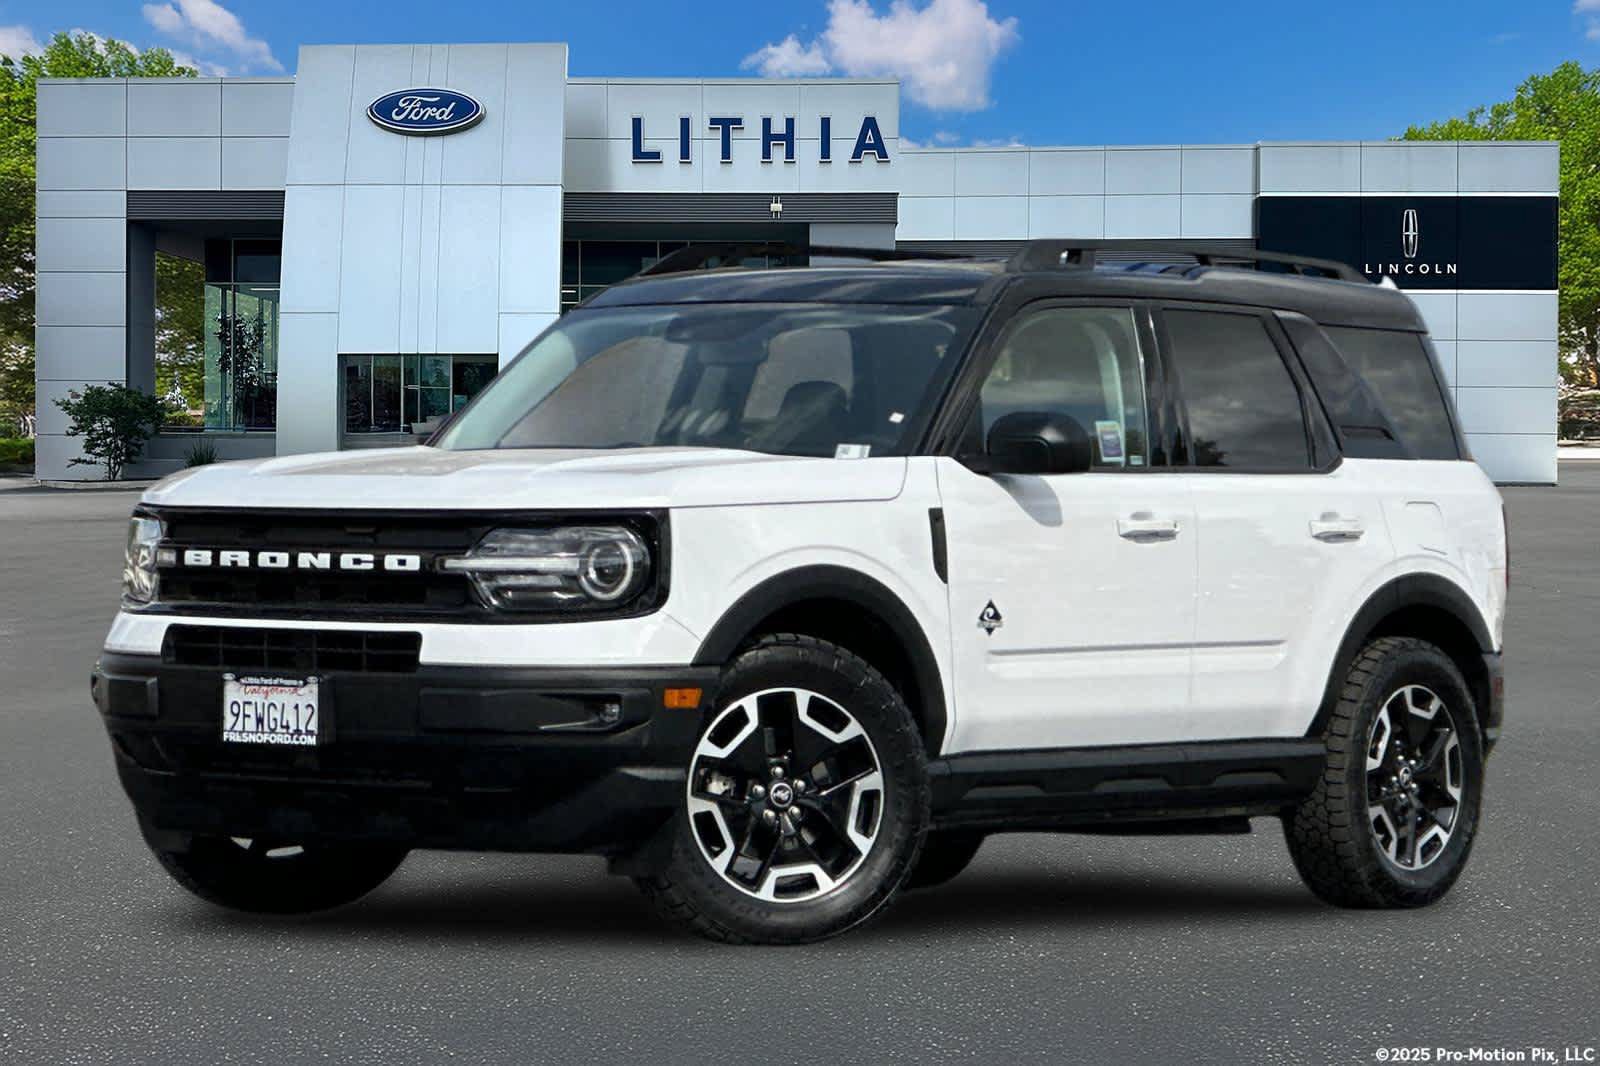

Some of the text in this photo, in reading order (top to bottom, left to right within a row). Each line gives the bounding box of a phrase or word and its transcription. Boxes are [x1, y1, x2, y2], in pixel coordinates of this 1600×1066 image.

[391, 96, 456, 120] Ford
[631, 116, 890, 163] LITHIA
[1365, 263, 1457, 274] LINCOLN
[184, 550, 421, 571] BRONCO
[230, 701, 315, 733] 9FWG412
[223, 732, 316, 745] FRESNOFORD.COM
